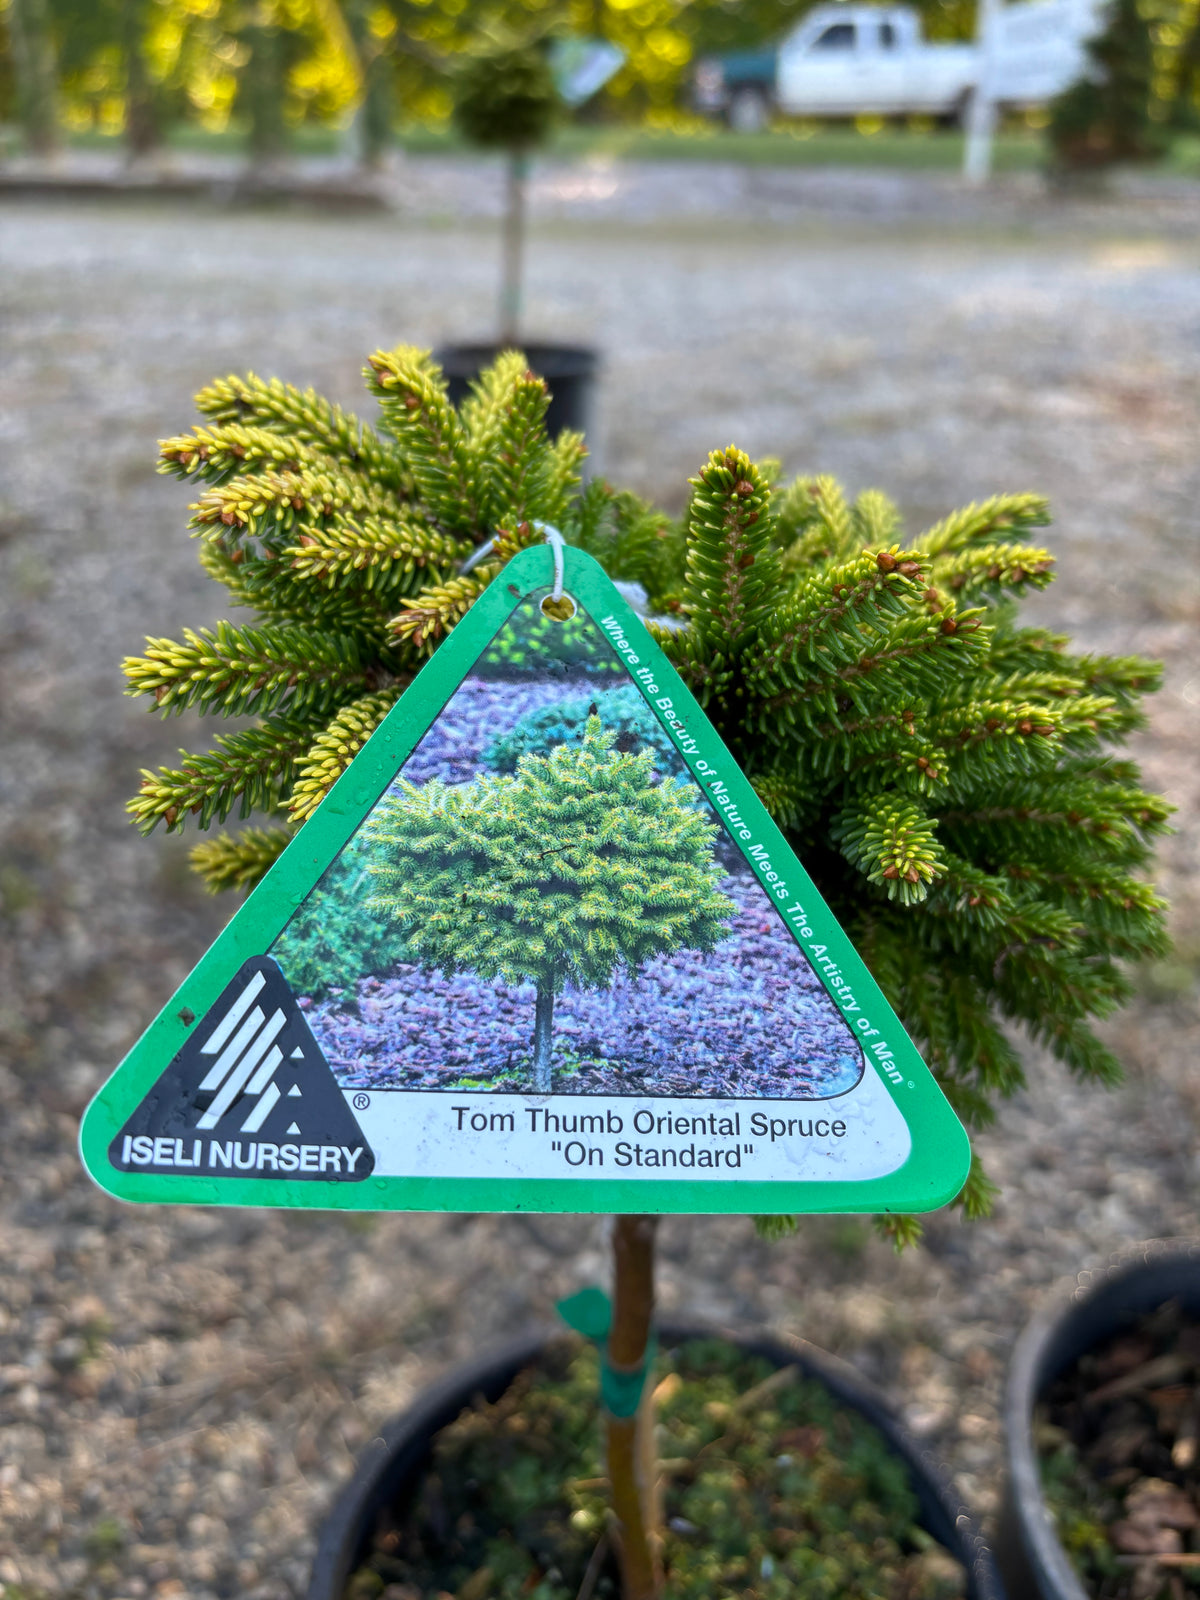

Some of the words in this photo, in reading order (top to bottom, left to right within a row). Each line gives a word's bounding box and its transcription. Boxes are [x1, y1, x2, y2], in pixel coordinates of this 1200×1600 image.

[601, 615, 640, 665] Where
[636, 667, 660, 695] the
[655, 697, 700, 755] Beauty
[695, 760, 717, 777] of
[709, 780, 752, 840] Nature
[748, 843, 789, 900] Meets
[786, 901, 813, 939] The
[809, 943, 860, 1013] Artistry
[856, 1017, 880, 1038] of
[870, 1040, 904, 1085] Man
[451, 1106, 515, 1132] Tom
[525, 1108, 624, 1134] Thumb
[633, 1110, 740, 1136] Oriental
[750, 1112, 847, 1142] Spruce
[121, 1135, 202, 1167] ISELI
[208, 1140, 363, 1173] NURSERY
[551, 1141, 604, 1167] "On
[613, 1142, 755, 1168] Standard"
